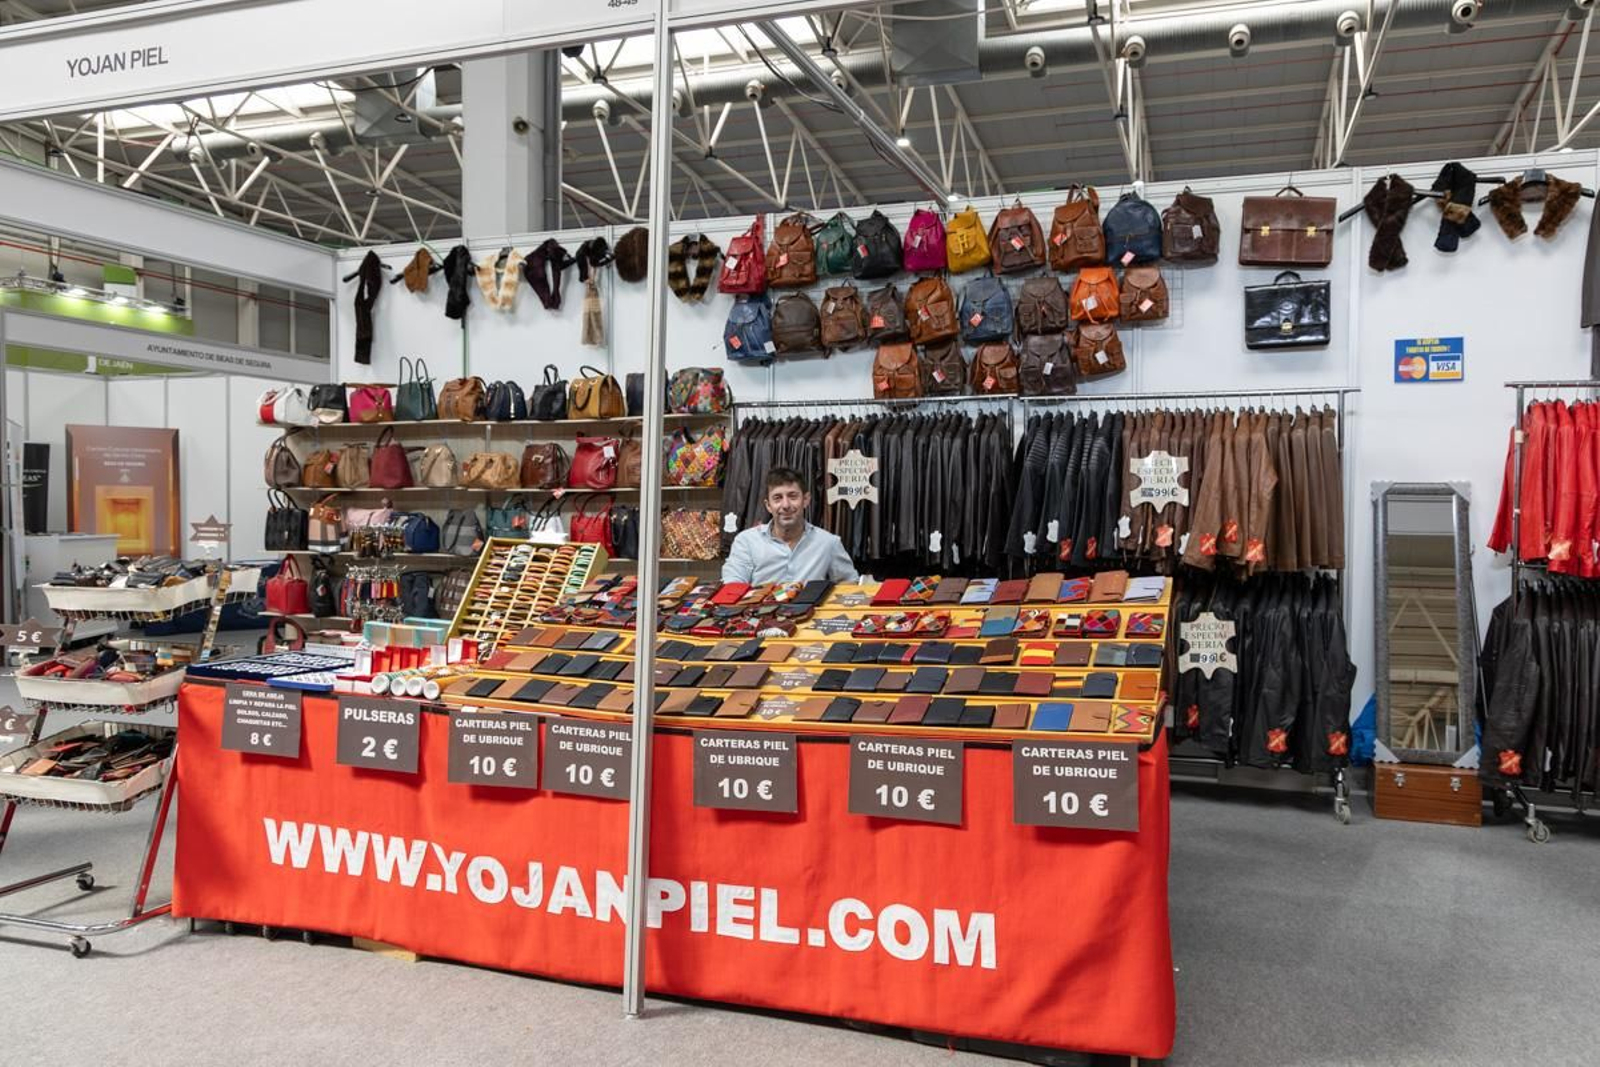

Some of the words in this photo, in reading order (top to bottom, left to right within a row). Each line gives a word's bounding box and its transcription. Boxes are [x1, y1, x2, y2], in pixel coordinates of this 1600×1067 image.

[67, 52, 125, 78] YOJAN
[130, 46, 168, 69] PIEL
[147, 344, 204, 359] AYUNTAMIENTO
[204, 352, 214, 360] DE
[235, 357, 245, 365] DE
[1436, 362, 1456, 371] VISA
[839, 475, 868, 483] FERIA
[1143, 475, 1175, 483] FERIA
[16, 630, 27, 642] 5
[31, 631, 42, 643] €
[1185, 631, 1227, 639] ESPECIAL
[1191, 640, 1224, 648] FERIA
[228, 698, 248, 706] LIMPIA
[254, 701, 276, 709] REPARA
[236, 717, 270, 726] CHAQUETAS
[344, 707, 414, 725] PULSERAS
[455, 718, 507, 730] CARTERAS
[509, 721, 532, 731] PIEL
[250, 732, 259, 745] 8
[263, 733, 272, 747] €
[463, 734, 476, 744] DE
[478, 735, 524, 746] UBRIQUE
[552, 724, 606, 738] CARTERAS
[608, 730, 632, 742] PIEL
[361, 736, 376, 758] 2
[383, 738, 398, 760] €
[559, 740, 573, 750] DE
[575, 742, 623, 756] UBRIQUE
[700, 738, 760, 749] CARTERAS
[763, 740, 789, 751] PIEL
[858, 741, 924, 756] CARTERAS
[927, 747, 955, 760] PIEL
[709, 754, 725, 764] DE
[728, 755, 780, 767] UBRIQUE
[1021, 747, 1094, 760] CARTERAS
[1097, 750, 1129, 761] PIEL
[469, 756, 496, 776] 10
[502, 757, 517, 777] €
[867, 759, 884, 770] DE
[887, 761, 944, 776] UBRIQUE
[1032, 765, 1051, 776] DE
[1054, 766, 1118, 779] UBRIQUE
[565, 763, 593, 785] 10
[600, 767, 615, 788] €
[718, 777, 749, 799] 10
[756, 779, 773, 800] €
[875, 784, 909, 808] 10
[917, 789, 935, 811] €
[1043, 791, 1079, 815] 10
[1089, 793, 1109, 817] €
[263, 817, 996, 970] WWW.YOJANPIEL.COM
